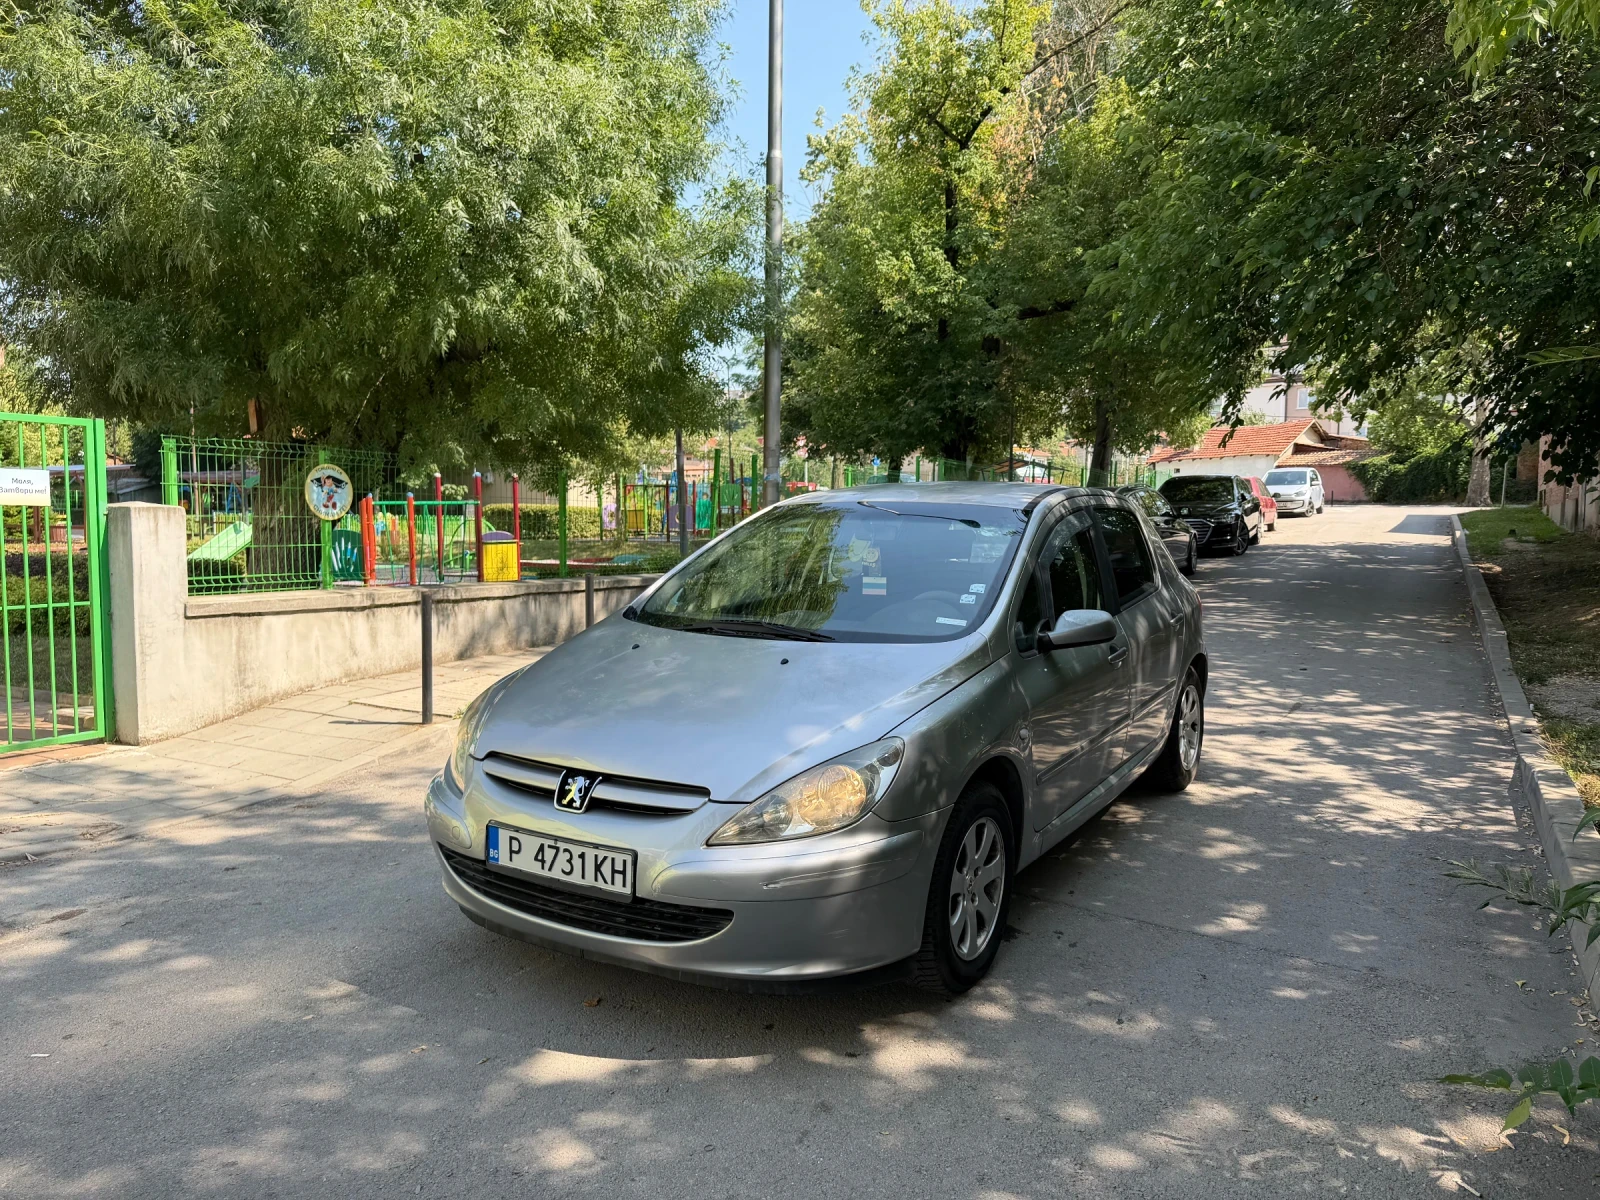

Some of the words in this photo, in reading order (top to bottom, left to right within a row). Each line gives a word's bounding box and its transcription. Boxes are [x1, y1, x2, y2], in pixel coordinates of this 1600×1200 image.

[489, 848, 499, 859] BG
[508, 835, 522, 862] P
[533, 842, 586, 880] 4731
